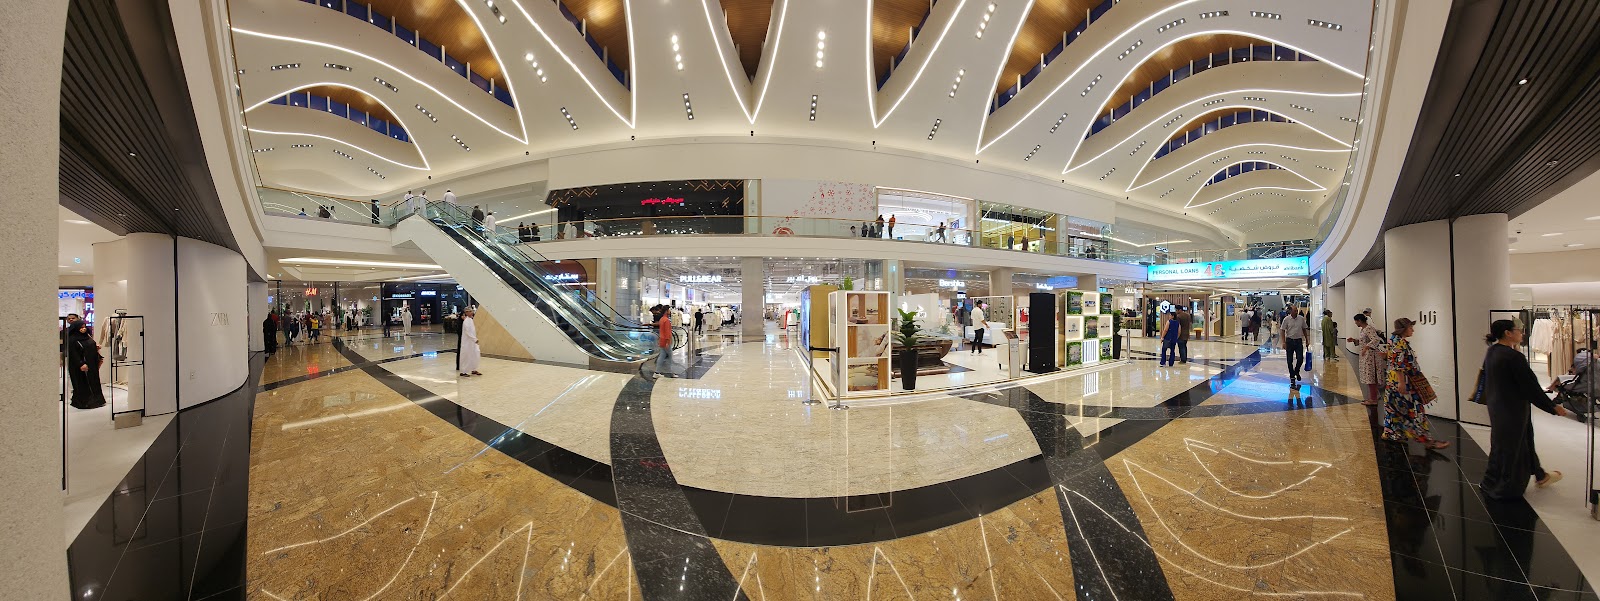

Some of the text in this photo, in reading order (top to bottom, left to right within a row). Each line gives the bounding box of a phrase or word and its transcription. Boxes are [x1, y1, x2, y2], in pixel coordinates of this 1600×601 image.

[939, 279, 965, 287] Bershka
[210, 312, 230, 326] ZARA
[1419, 310, 1437, 325] زارا
